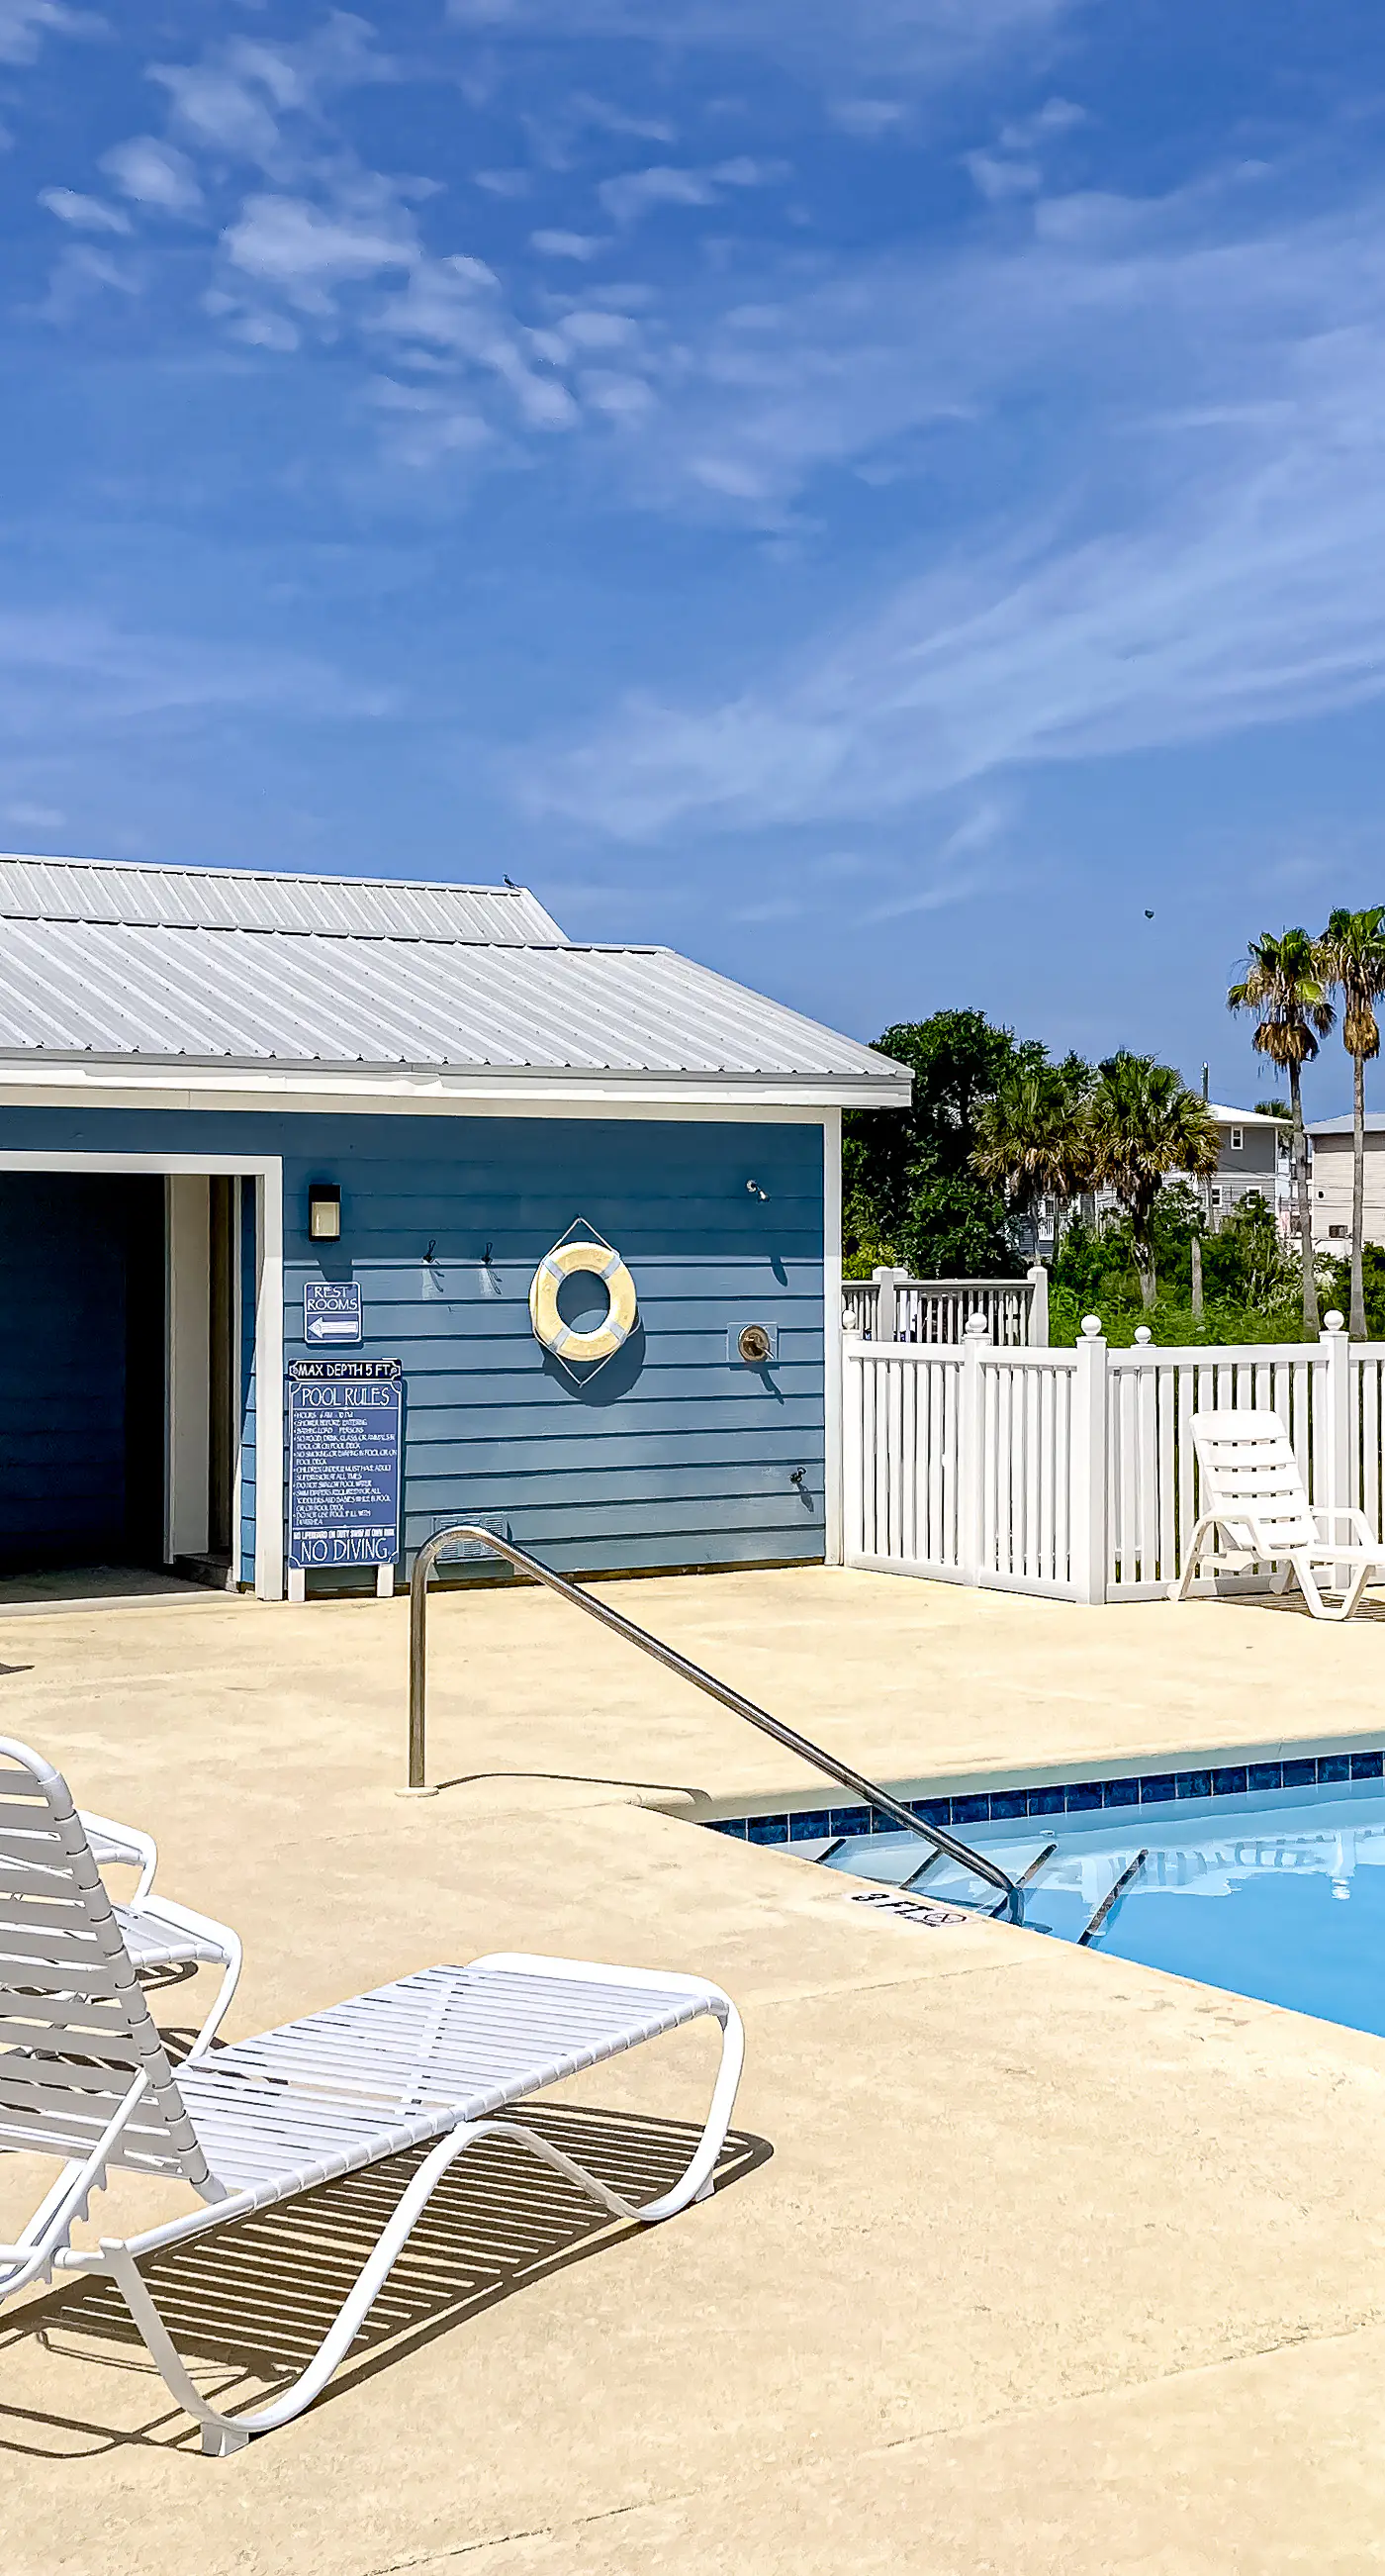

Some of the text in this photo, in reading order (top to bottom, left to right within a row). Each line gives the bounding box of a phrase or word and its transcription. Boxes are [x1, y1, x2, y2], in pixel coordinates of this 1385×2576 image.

[314, 1287, 348, 1297] REST
[307, 1298, 357, 1311] ROOMS
[298, 1364, 323, 1377] MAX
[326, 1364, 363, 1377] DEPTH
[365, 1364, 373, 1377] 5
[301, 1387, 390, 1406] POOL RULES
[301, 1537, 388, 1563] NO DIVING
